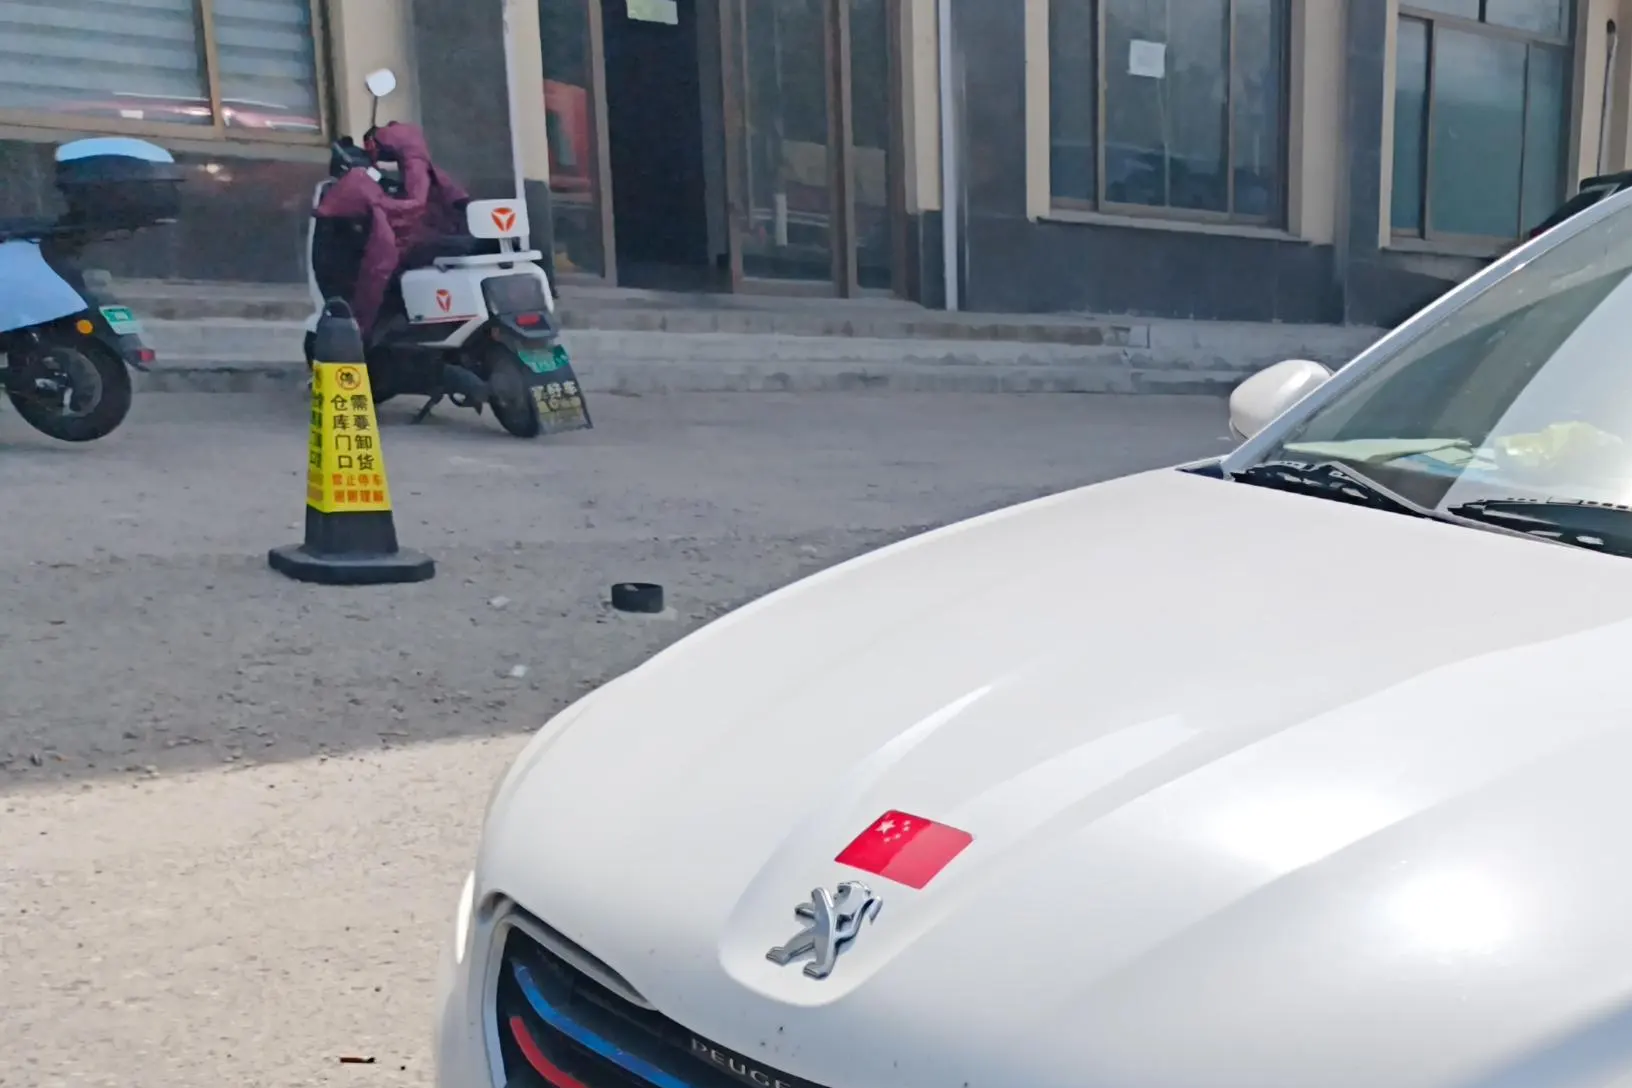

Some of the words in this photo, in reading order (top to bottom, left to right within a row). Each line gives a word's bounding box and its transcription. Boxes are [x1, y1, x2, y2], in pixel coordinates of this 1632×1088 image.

[331, 394, 353, 469] 仓库门口
[351, 394, 374, 470] 需要卸货
